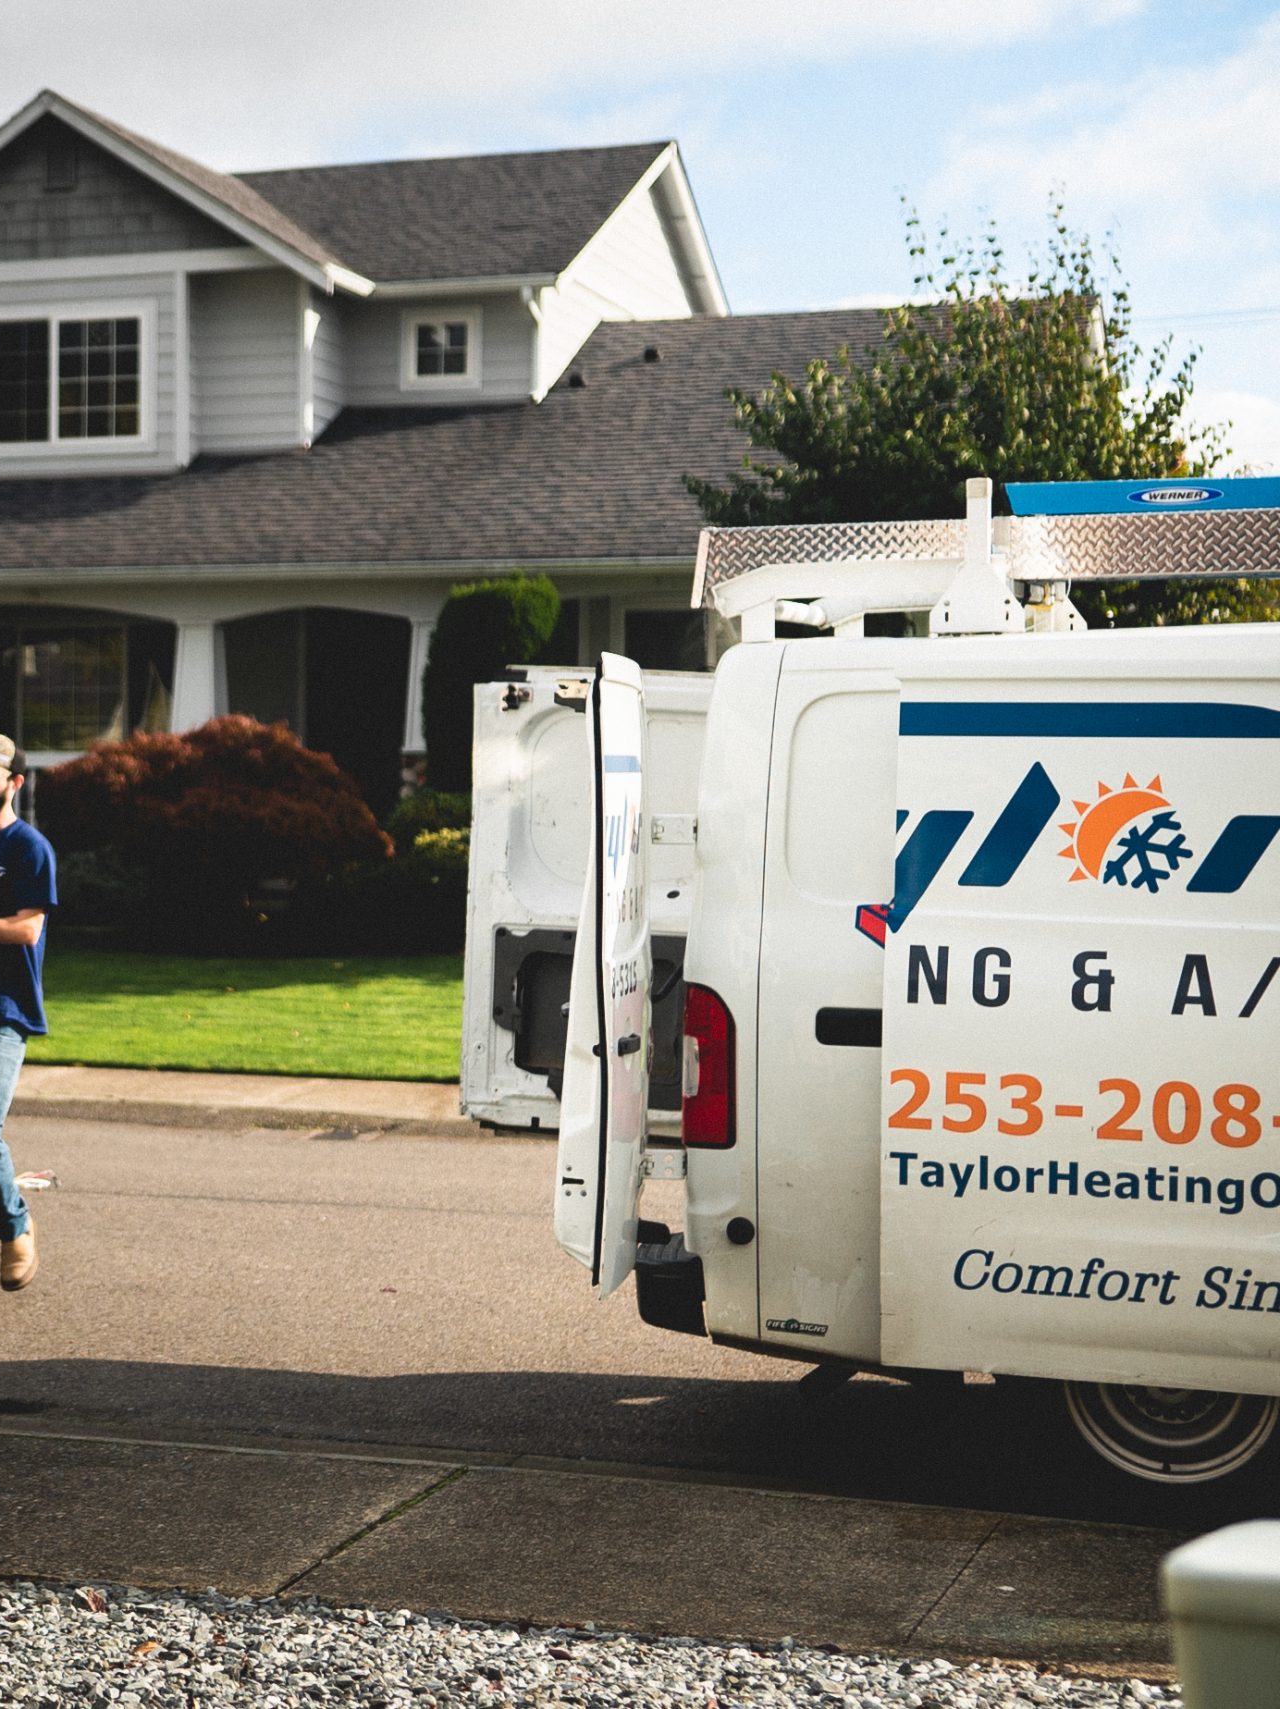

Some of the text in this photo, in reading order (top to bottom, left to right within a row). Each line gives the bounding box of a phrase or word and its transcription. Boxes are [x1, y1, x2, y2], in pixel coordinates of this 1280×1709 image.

[1149, 491, 1203, 501] WERNER
[1071, 950, 1116, 1013] &
[888, 1068, 1280, 1149] 253-208
[952, 1248, 1180, 1305] Comfort
